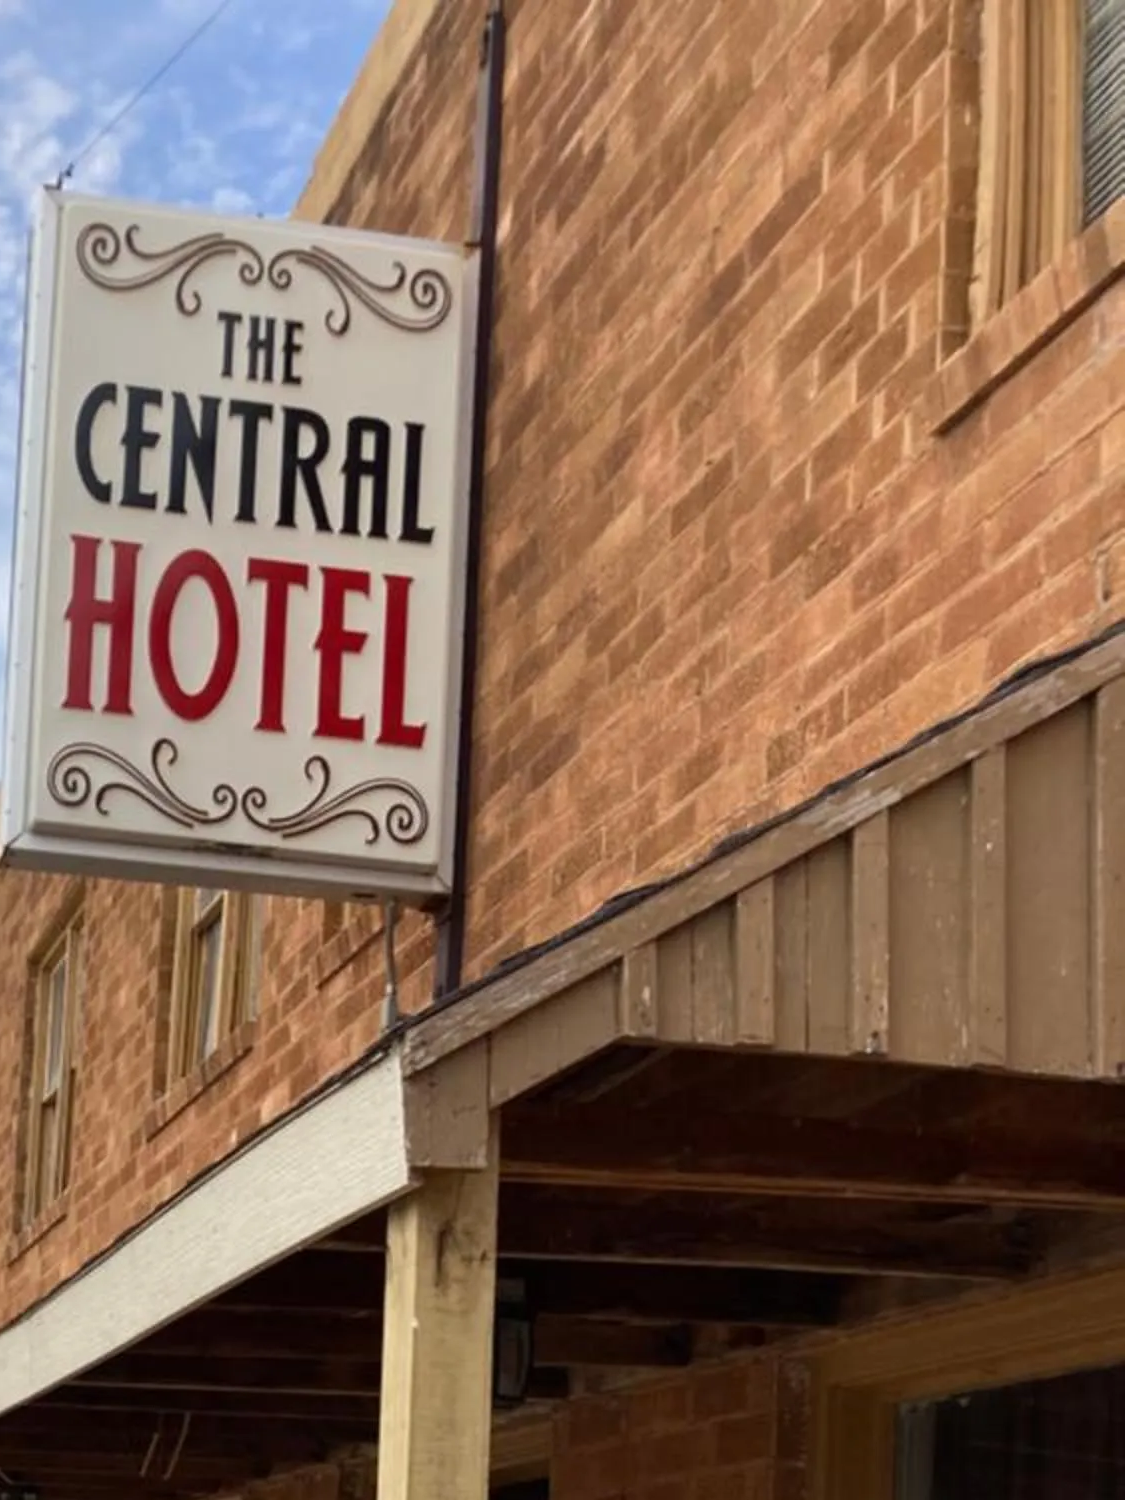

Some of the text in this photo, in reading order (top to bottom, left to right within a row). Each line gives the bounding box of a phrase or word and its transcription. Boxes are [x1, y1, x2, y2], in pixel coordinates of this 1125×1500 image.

[217, 310, 305, 385] THE
[76, 382, 436, 545] CENTRAL
[61, 534, 428, 749] HOTEL
